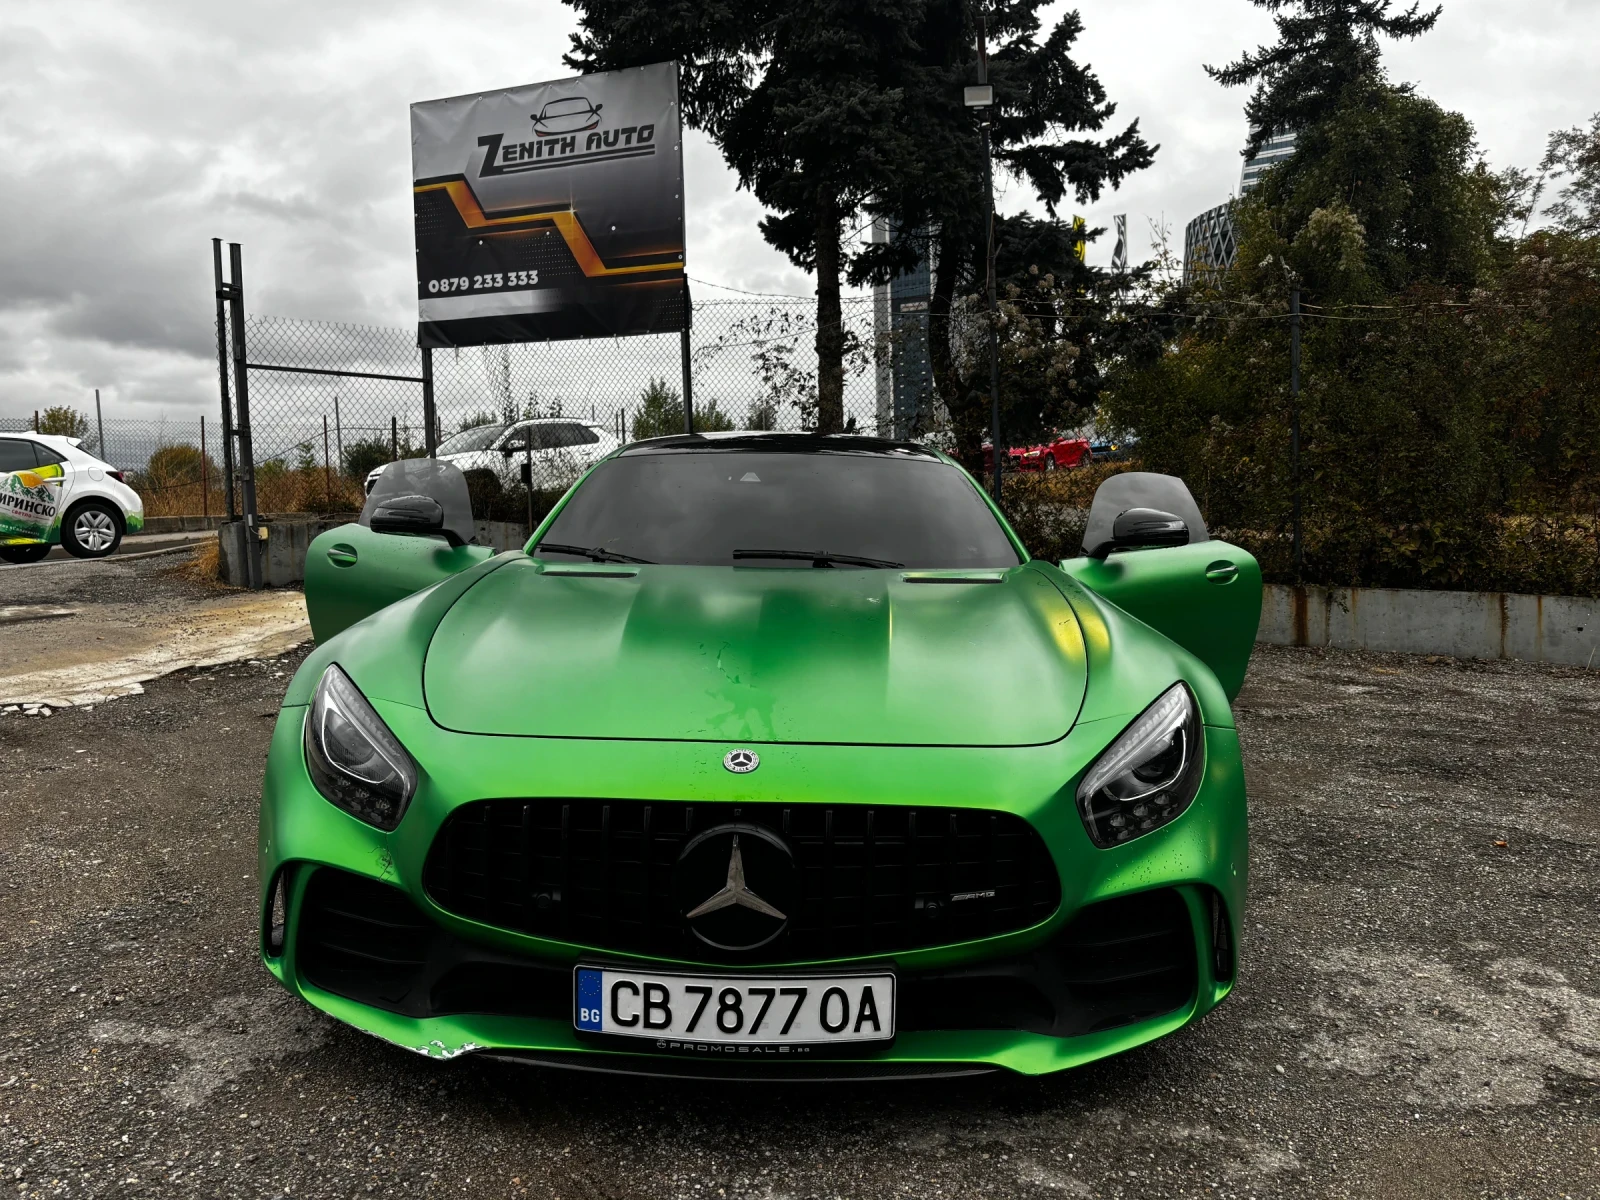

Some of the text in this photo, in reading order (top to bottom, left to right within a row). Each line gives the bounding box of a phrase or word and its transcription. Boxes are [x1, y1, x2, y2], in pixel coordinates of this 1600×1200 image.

[477, 124, 655, 178] ZENITH AUTO
[428, 270, 539, 293] 0879 233 333
[580, 1008, 600, 1023] BG
[610, 980, 882, 1035] CB 7877 OA
